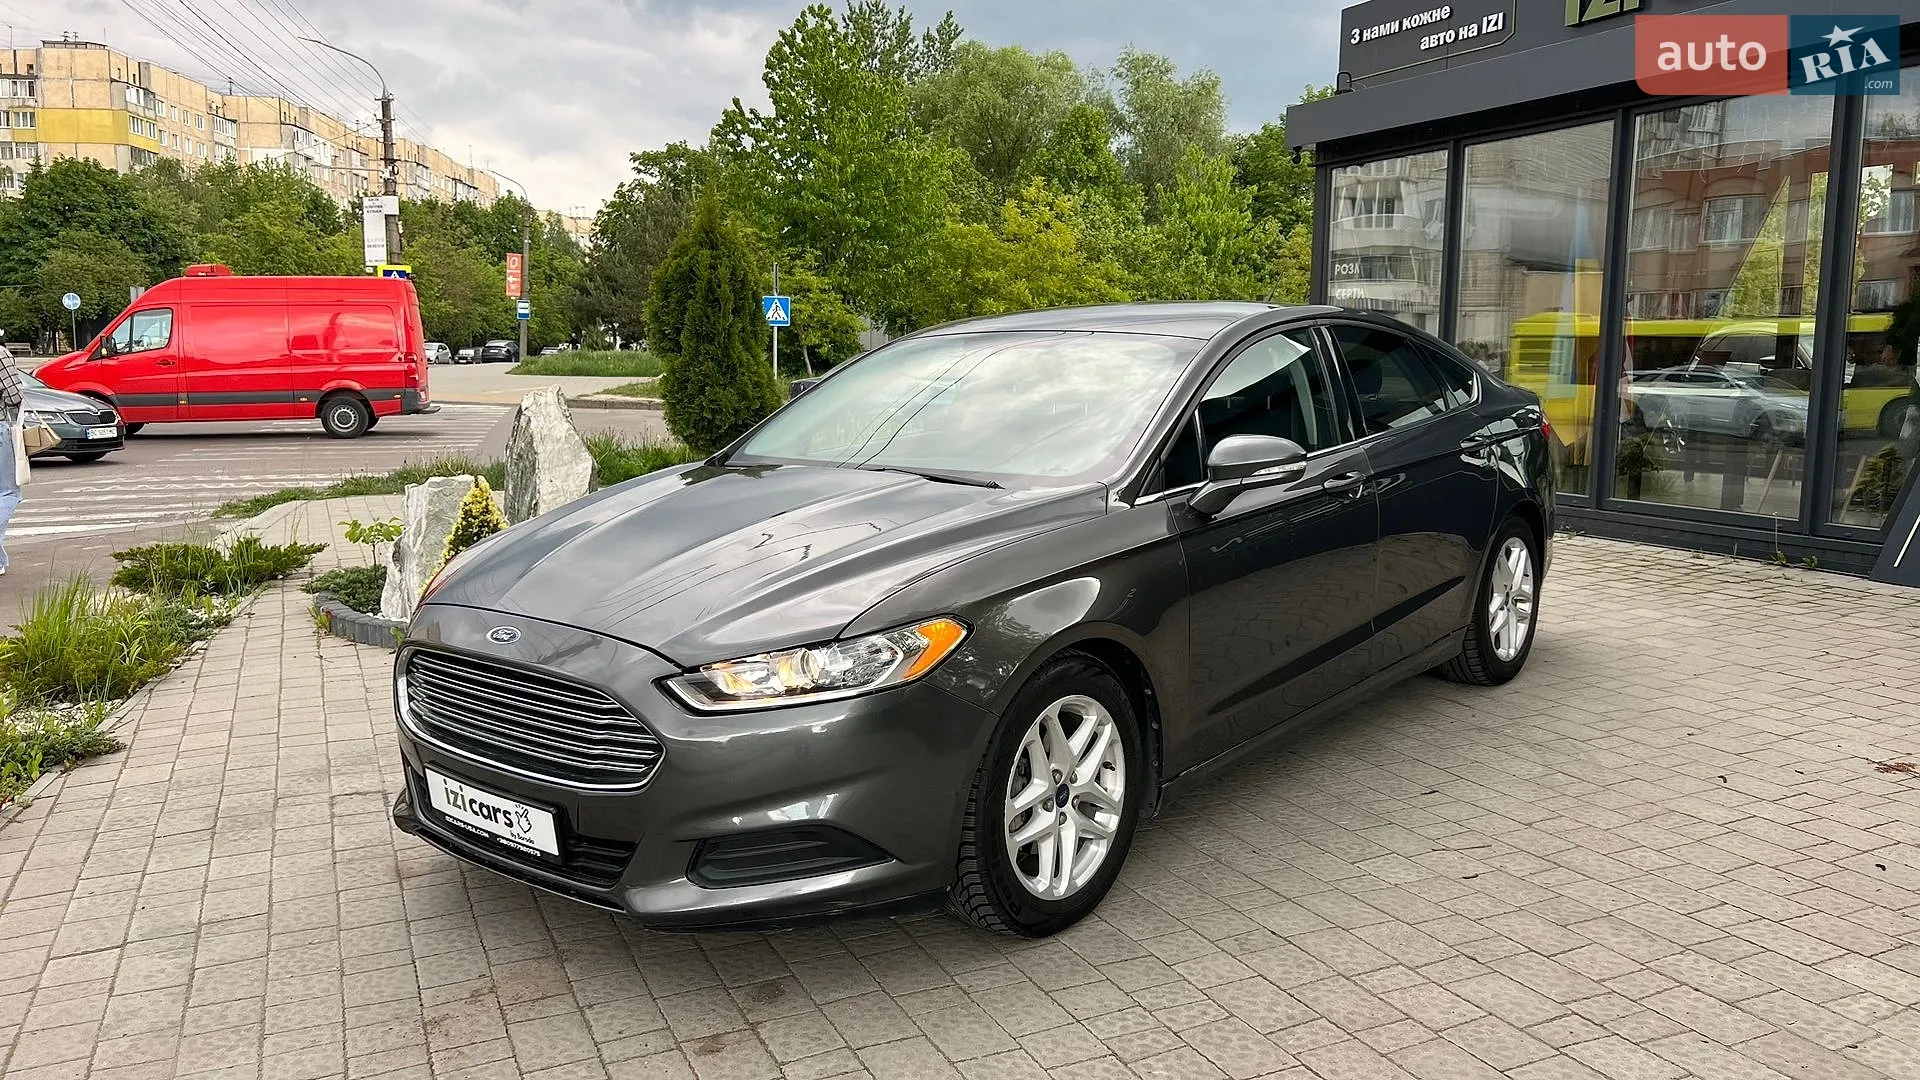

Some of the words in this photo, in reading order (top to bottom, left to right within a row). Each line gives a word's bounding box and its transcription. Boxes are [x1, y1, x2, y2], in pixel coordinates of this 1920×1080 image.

[1363, 20, 1399, 42] нами
[1402, 5, 1450, 31] кожне
[1420, 32, 1455, 50] авто
[1458, 23, 1478, 40] на
[1481, 12, 1504, 35] IZI
